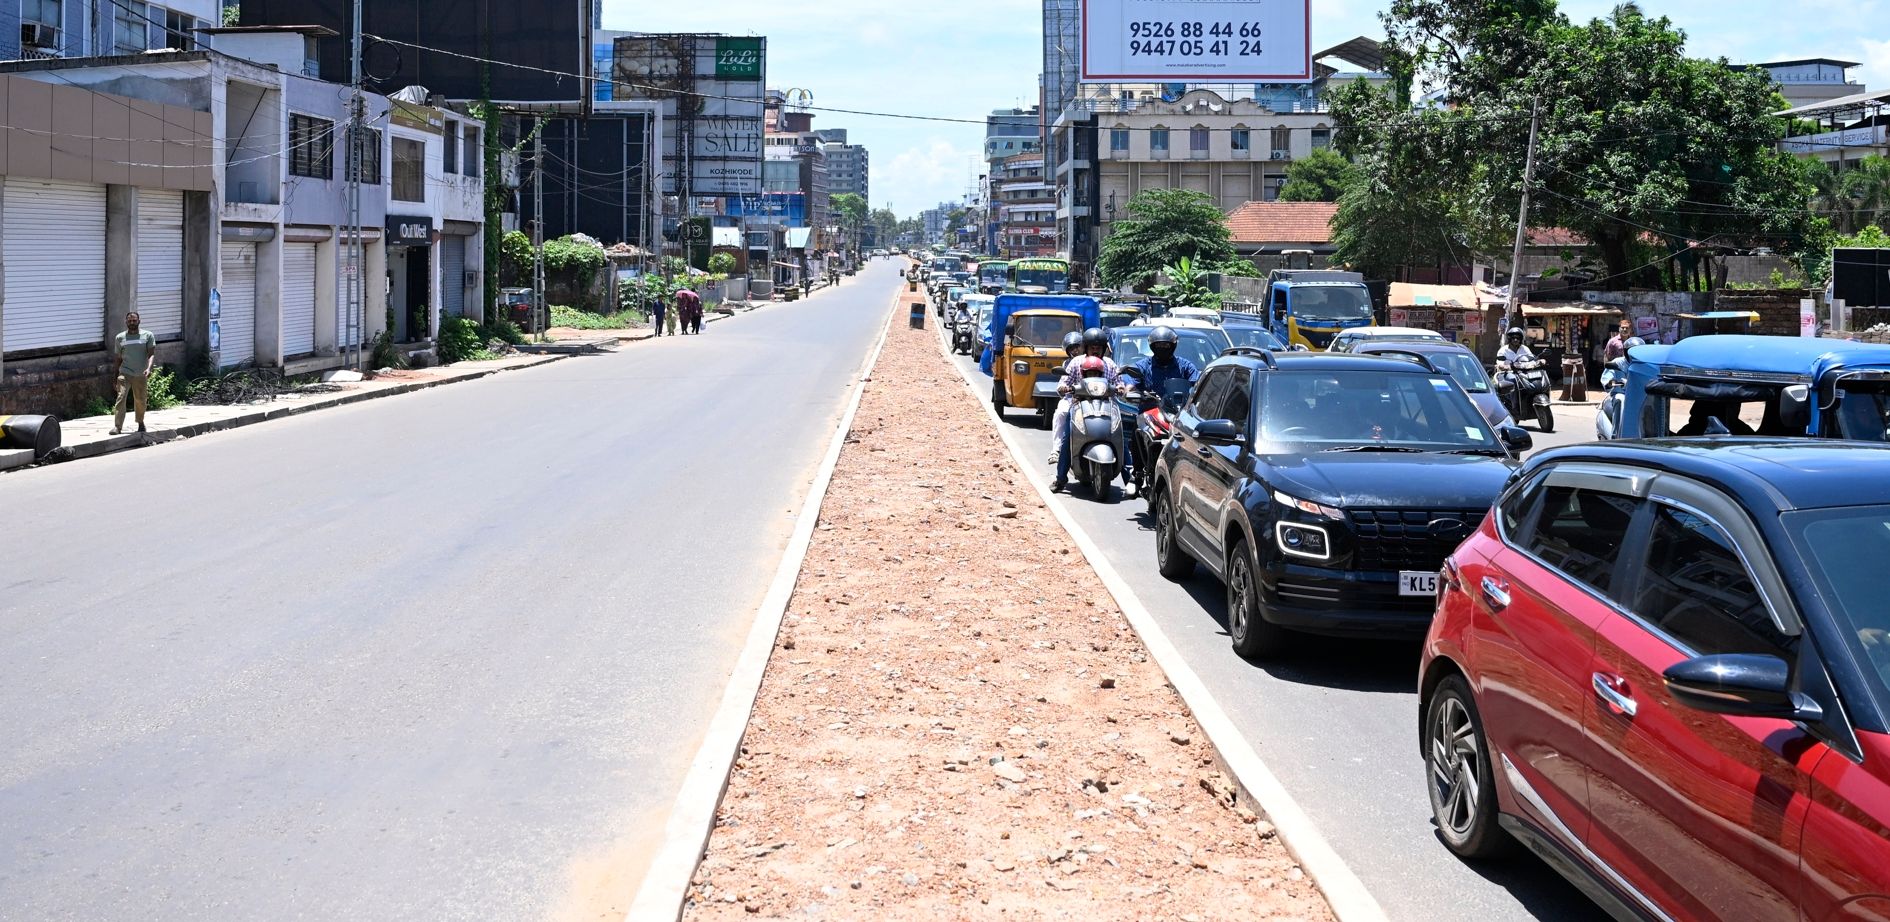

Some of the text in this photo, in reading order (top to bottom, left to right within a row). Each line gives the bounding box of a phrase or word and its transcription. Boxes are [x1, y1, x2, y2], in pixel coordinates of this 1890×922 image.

[1130, 22, 1261, 38] 9526 88 44 66
[1130, 40, 1262, 56] 9447 05 41 24
[718, 50, 758, 65] LuLu
[706, 118, 759, 131] WINTER
[705, 132, 759, 152] SALE
[414, 224, 427, 238] West
[1019, 261, 1065, 271] FANTASY
